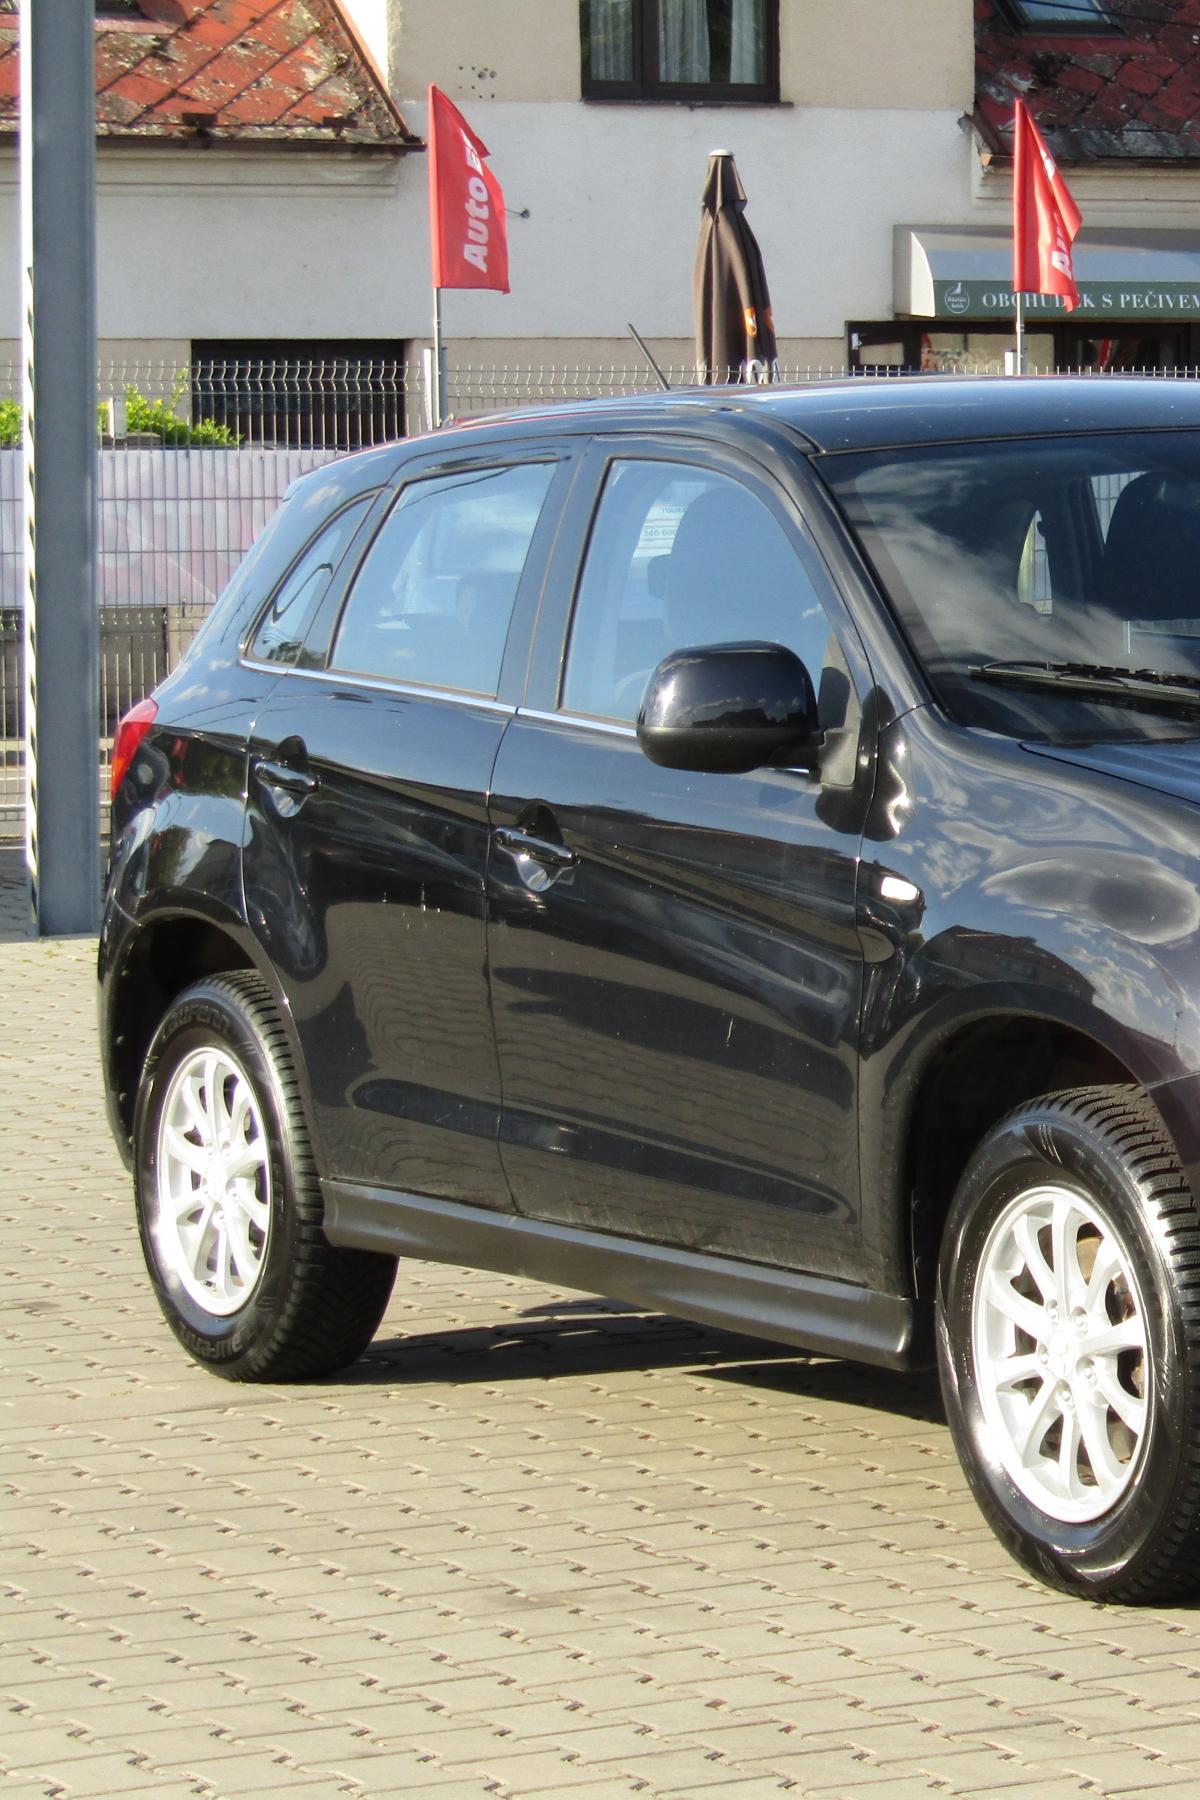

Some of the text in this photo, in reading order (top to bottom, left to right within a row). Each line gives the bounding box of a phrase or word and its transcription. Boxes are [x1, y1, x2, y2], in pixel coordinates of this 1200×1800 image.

[463, 178, 489, 273] Auto
[982, 292, 1096, 309] OBHUDK
[1102, 293, 1114, 309] S
